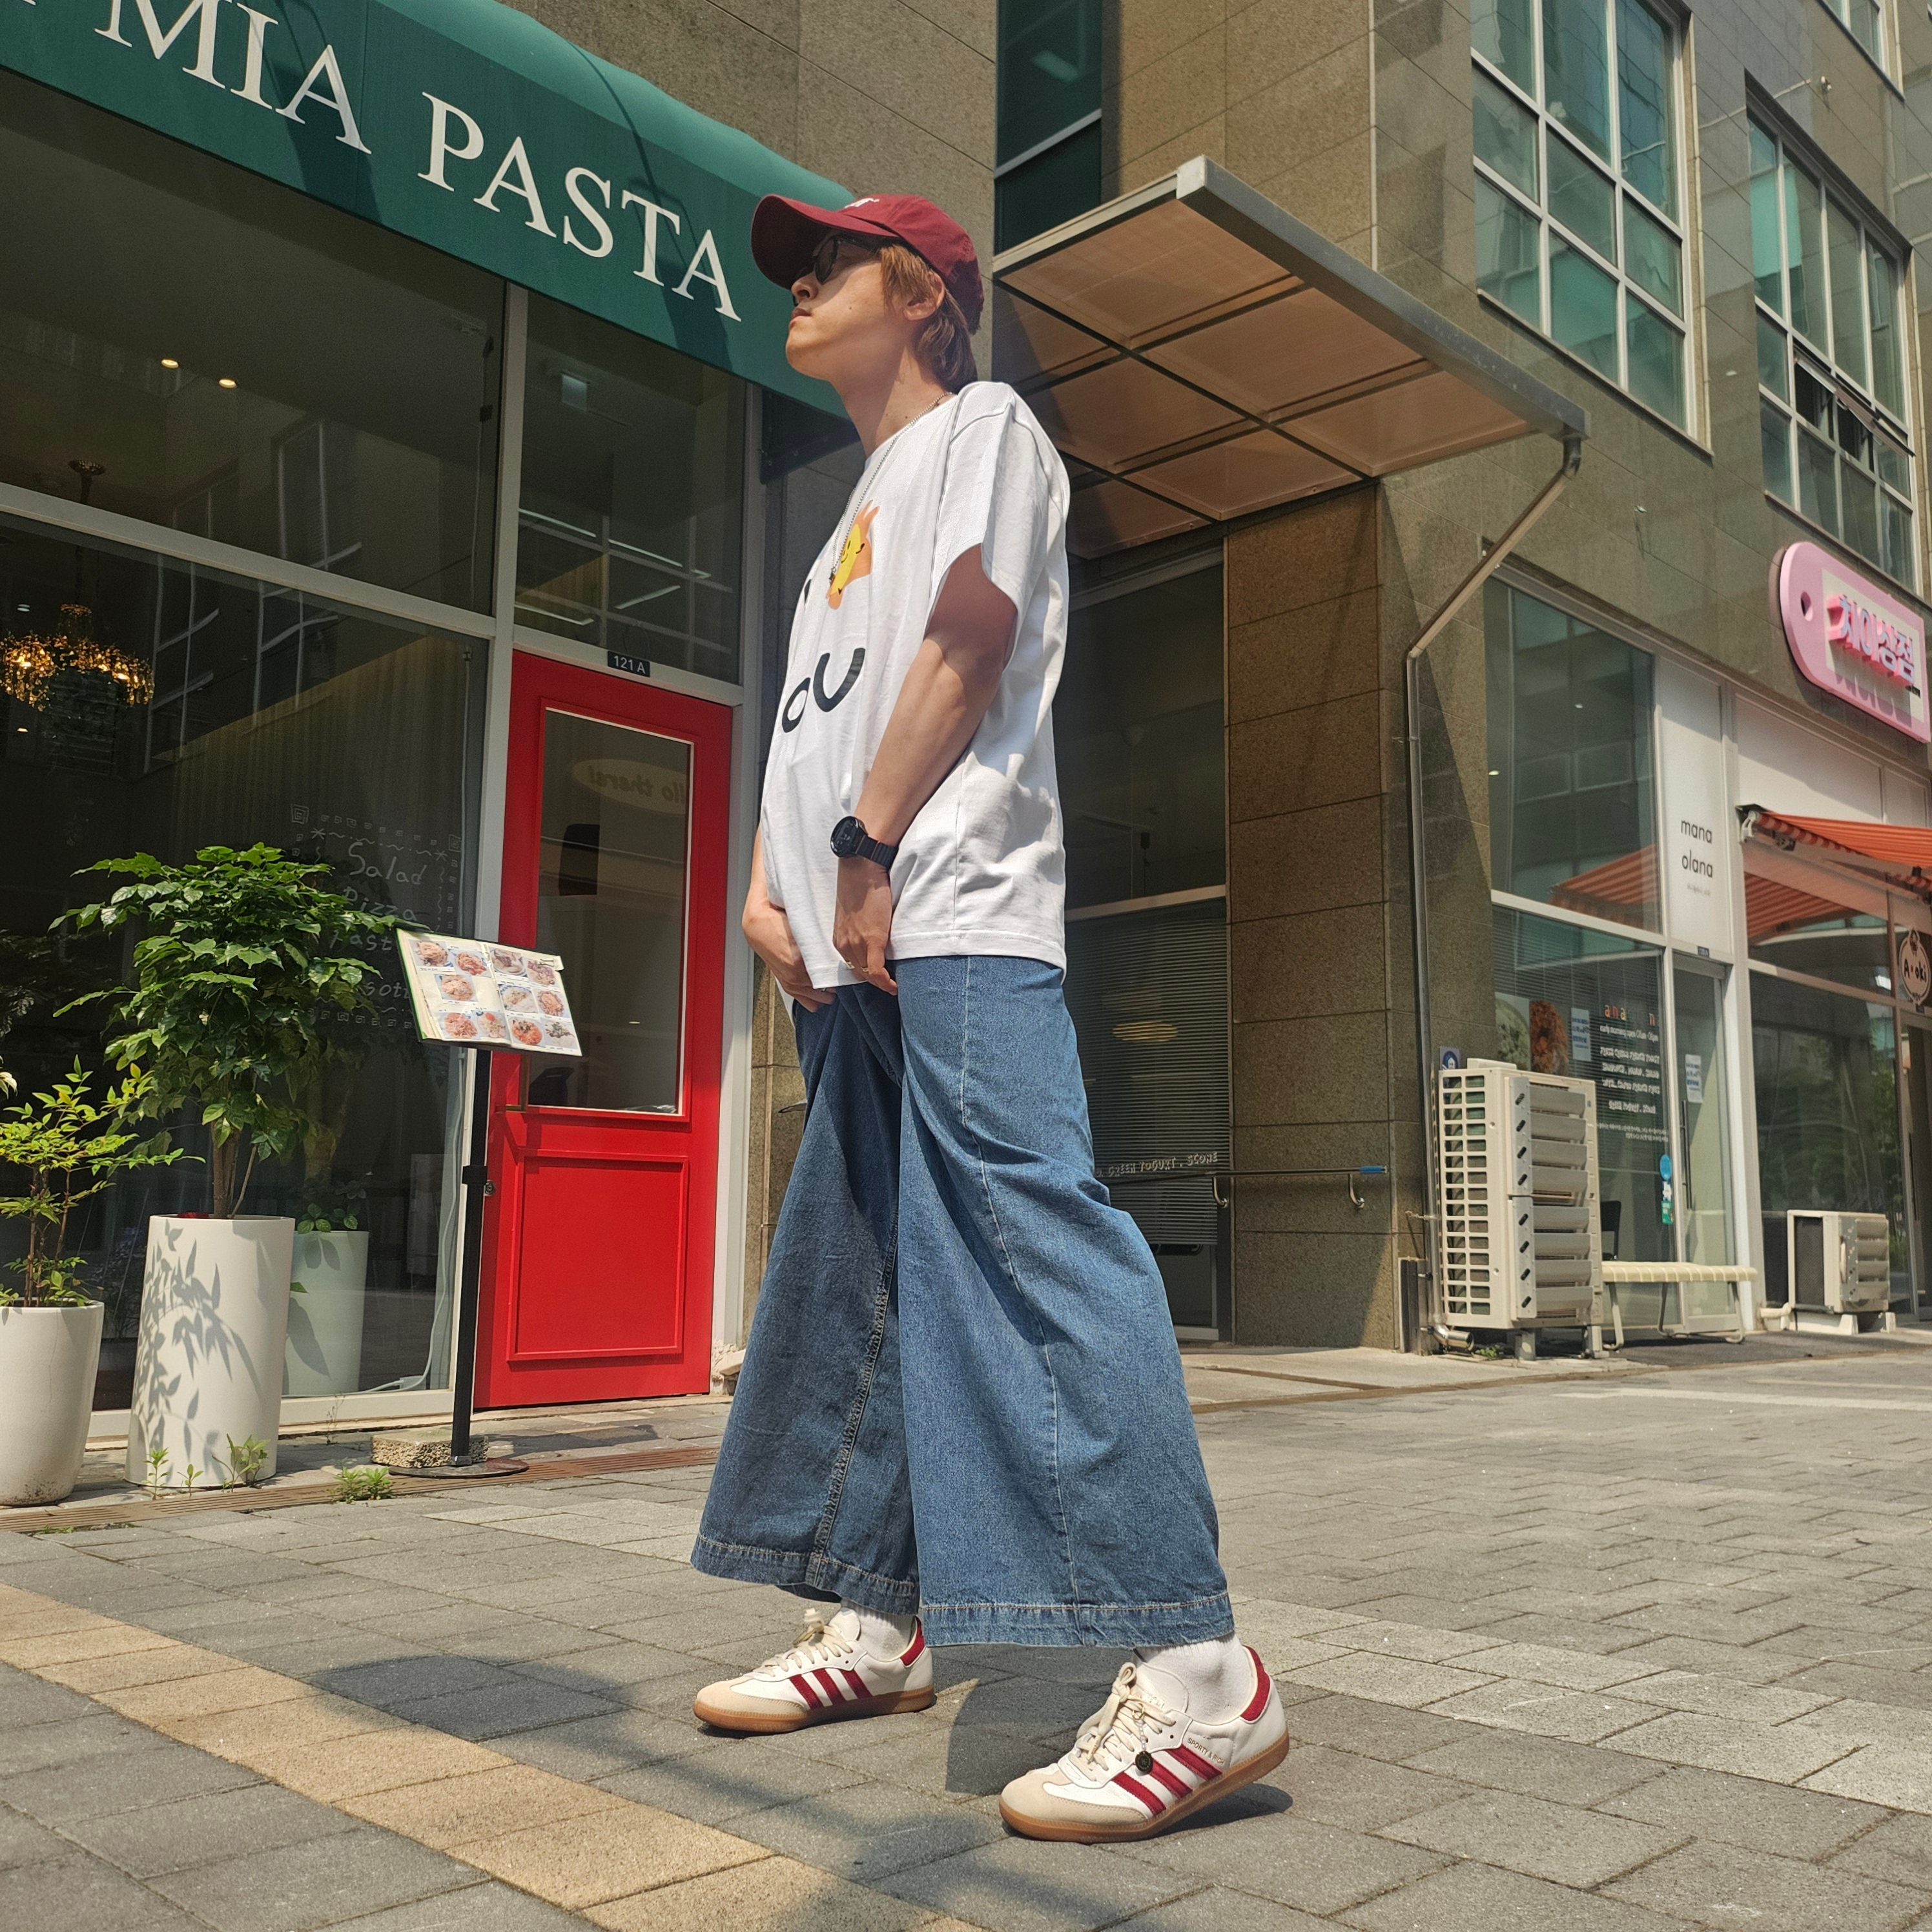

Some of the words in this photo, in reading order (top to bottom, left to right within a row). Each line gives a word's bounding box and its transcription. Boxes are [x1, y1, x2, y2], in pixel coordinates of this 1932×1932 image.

[94, 0, 372, 154] MIA
[417, 91, 742, 323] PASTA
[613, 655, 634, 672] 121
[637, 661, 646, 675] A
[1680, 819, 1713, 844] mana
[349, 841, 428, 885] Salad
[1681, 849, 1714, 878] olana
[329, 929, 393, 951] Past
[1140, 1157, 1176, 1171] YOGURT
[1186, 1152, 1218, 1166] SCONE
[1187, 1738, 1209, 1754] SPORTY
[1213, 1754, 1225, 1765] RICH
